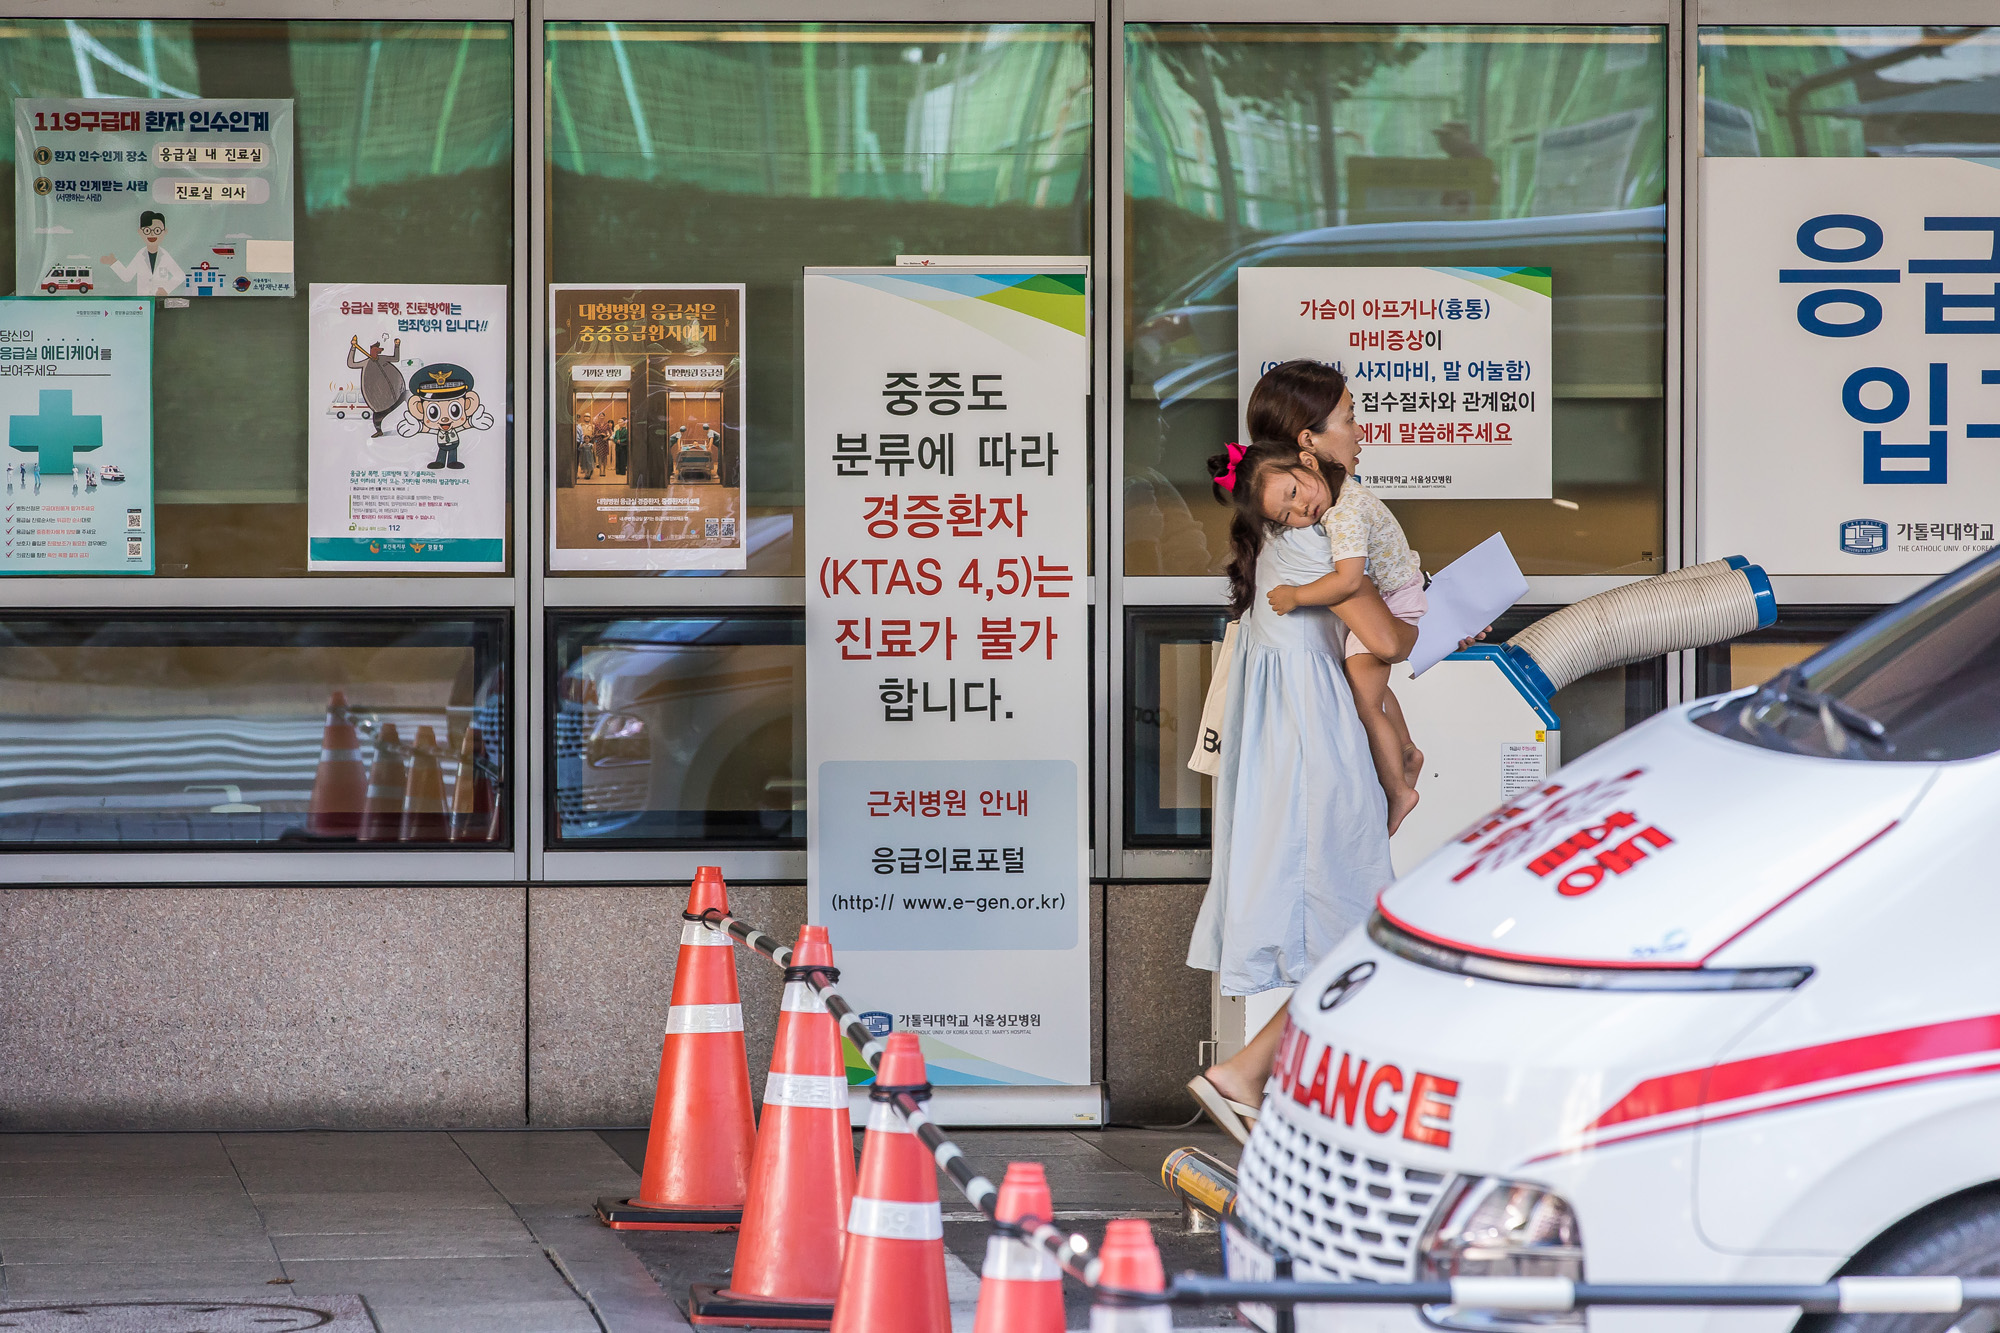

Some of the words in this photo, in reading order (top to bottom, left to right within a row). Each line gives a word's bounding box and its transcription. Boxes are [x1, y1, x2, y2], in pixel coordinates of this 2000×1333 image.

[34, 111, 140, 132] 119구급대
[145, 111, 185, 132] 환자
[189, 111, 269, 132] 인수인계
[55, 151, 76, 162] 환자
[126, 151, 148, 162] 장소
[159, 148, 197, 162] 응급실
[205, 148, 217, 162] 내
[225, 148, 262, 162] 진료실
[55, 181, 76, 192] 환자
[79, 181, 123, 192] 인계받는
[126, 180, 148, 192] 사람
[176, 186, 213, 199] 진료실
[221, 186, 246, 199] 의사
[56, 194, 85, 202] (서명하는
[86, 194, 102, 202] 사람)
[1779, 214, 2000, 338] 응급
[340, 301, 373, 315] 응급실
[377, 301, 402, 315] 폭행,
[406, 301, 462, 315] 진료방해는
[579, 304, 645, 321] 대형병원
[651, 304, 717, 321] 응급실은
[1300, 299, 1355, 320] 가슴이
[1363, 299, 1490, 320] 아프거나(흉통)
[398, 319, 442, 332] 범죄행위
[446, 319, 489, 332] 입니다!!
[579, 325, 717, 342] 중증응급환자에게
[0, 330, 33, 342] 당신의
[1349, 330, 1442, 351] 마비증상이
[0, 347, 37, 360] 응급실
[41, 345, 112, 360] 에티케어를
[0, 365, 57, 376] 보여주세요
[582, 369, 605, 377] 가까운
[606, 369, 621, 377] 병원
[667, 368, 698, 377] 대형병원
[700, 368, 722, 377] 응급실
[1355, 361, 1436, 381] 사지마비,
[1443, 361, 1461, 381] 말
[1467, 361, 1531, 381] 어눌함)
[882, 373, 1007, 416] 중증도
[1361, 392, 1456, 413] 접수절차와
[1462, 392, 1535, 413] 관계없이
[1359, 423, 1391, 443] 에게
[1399, 423, 1513, 443] 말씀해주세요
[832, 432, 954, 476] 분류에
[979, 432, 1059, 476] 따라
[1365, 475, 1407, 484] 가톨릭대학교
[1410, 475, 1452, 484] 서울성모병원
[863, 494, 1028, 538] 경증환자
[1897, 523, 1994, 541] 가톨릭대학교
[819, 557, 942, 598] (KTAS
[958, 555, 1073, 602] 4,5)는
[835, 616, 957, 660] 진료가
[977, 616, 1058, 660] 불가
[879, 678, 1013, 722] 합니다.
[867, 789, 967, 817] 근처병원
[979, 789, 1028, 817] 안내
[872, 847, 1025, 875] 응급의료포털
[832, 893, 894, 913] (http://
[903, 893, 1066, 913] www.e-gen.or.kr)
[899, 1014, 969, 1027] 가톨릭대학교
[973, 1014, 1041, 1027] 서울성모병원
